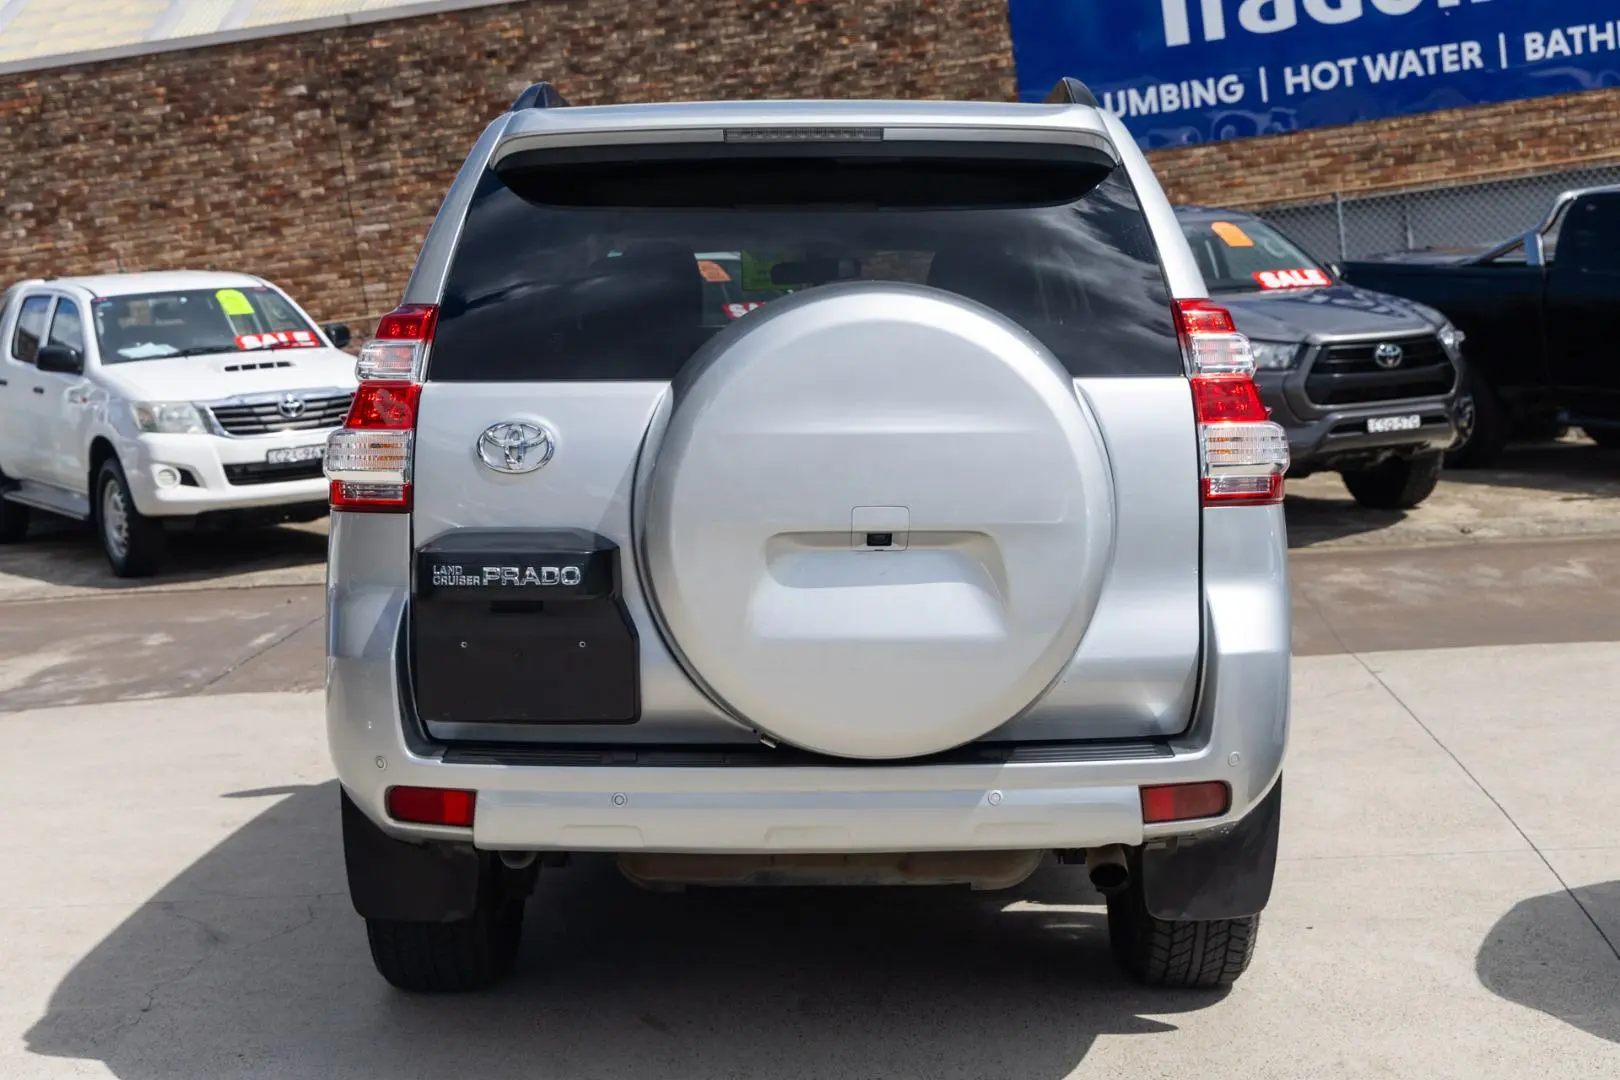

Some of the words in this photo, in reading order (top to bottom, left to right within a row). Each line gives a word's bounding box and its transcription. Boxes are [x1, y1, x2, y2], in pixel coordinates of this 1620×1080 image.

[1103, 74, 1244, 118] UMBING
[1284, 57, 1358, 95] HOT
[1362, 40, 1485, 83] WATER
[1524, 20, 1620, 61] BATH
[1258, 269, 1328, 288] SALE
[432, 565, 463, 575] LAND
[482, 566, 581, 586] PRADO
[432, 575, 480, 586] CRUISER
